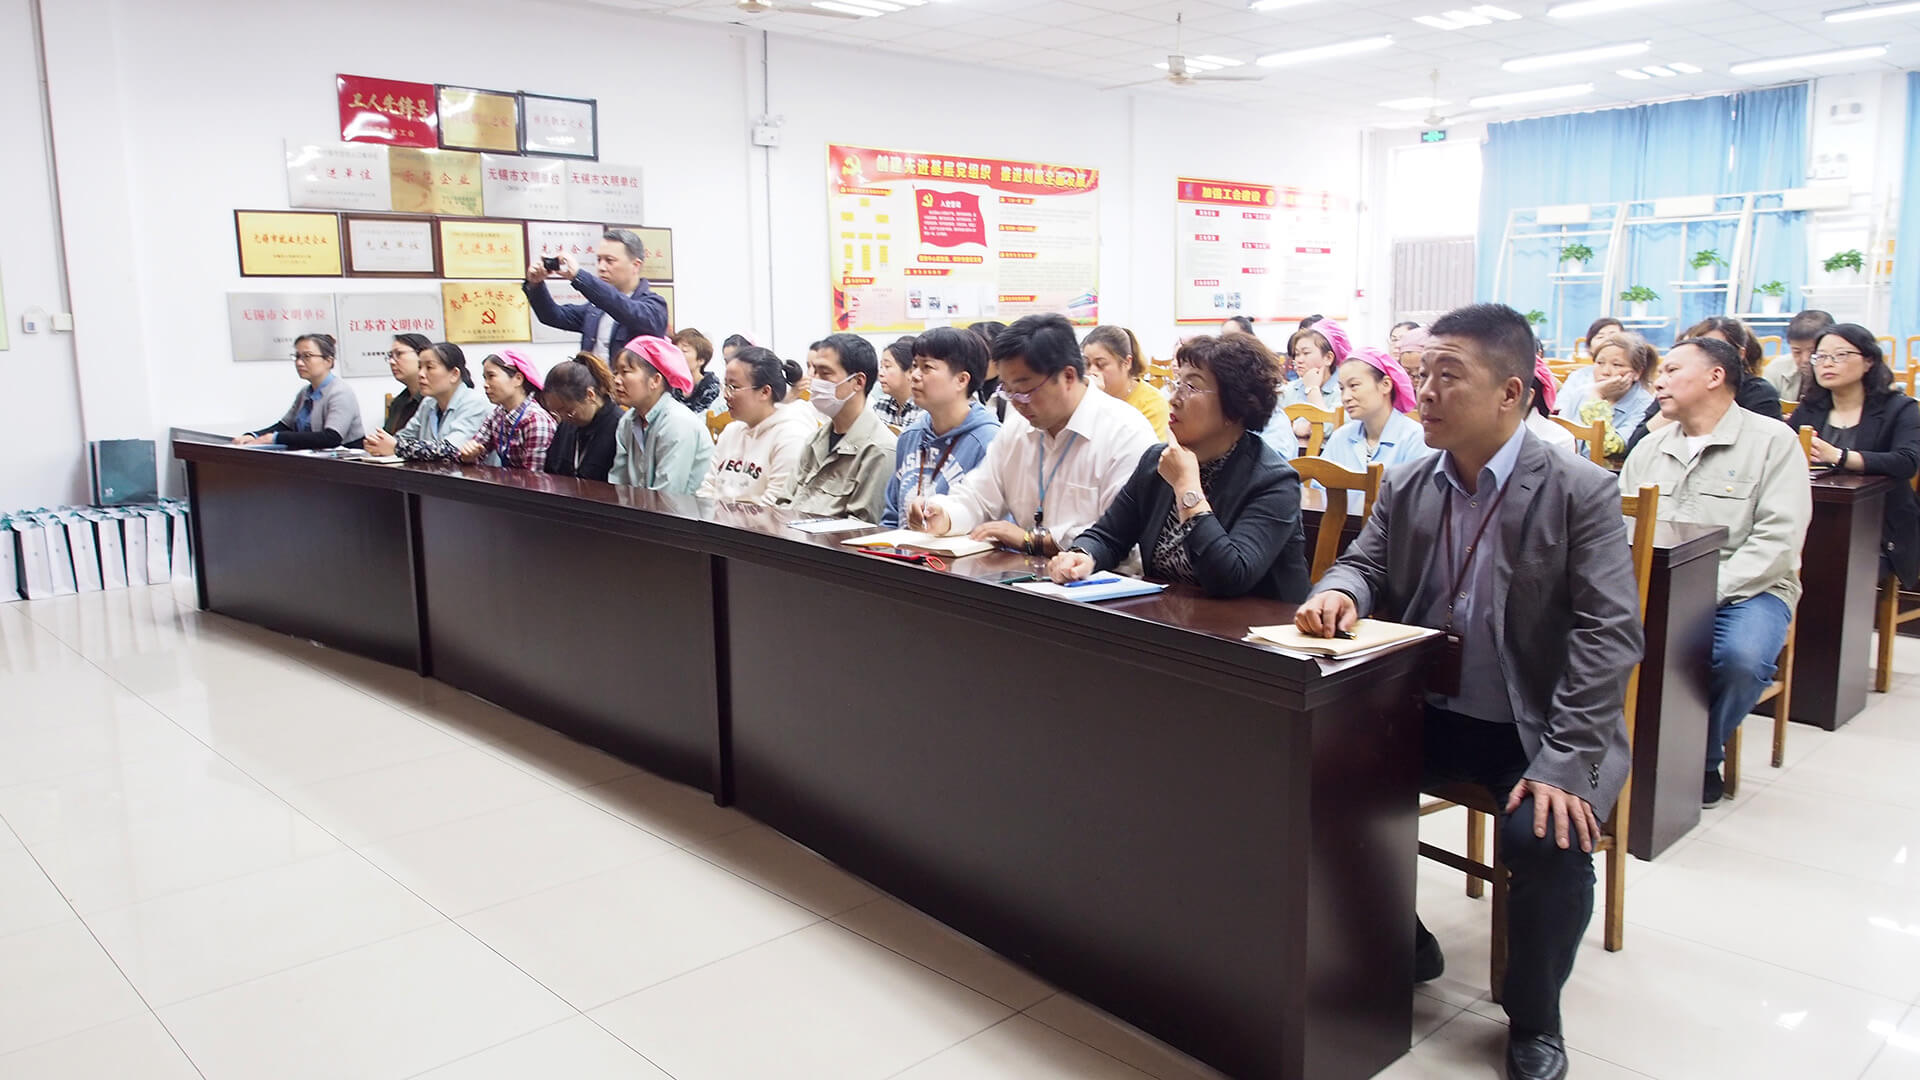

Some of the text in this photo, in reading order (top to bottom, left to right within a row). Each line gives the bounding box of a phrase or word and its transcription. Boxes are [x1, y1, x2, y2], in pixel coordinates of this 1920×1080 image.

[348, 93, 430, 123] 工人先锋号
[487, 167, 561, 186] 无锡市文明单位
[571, 172, 639, 189] 无锡市文明单位
[243, 308, 327, 321] 无锡市文明单位
[348, 318, 436, 333] 江苏省文明单位
